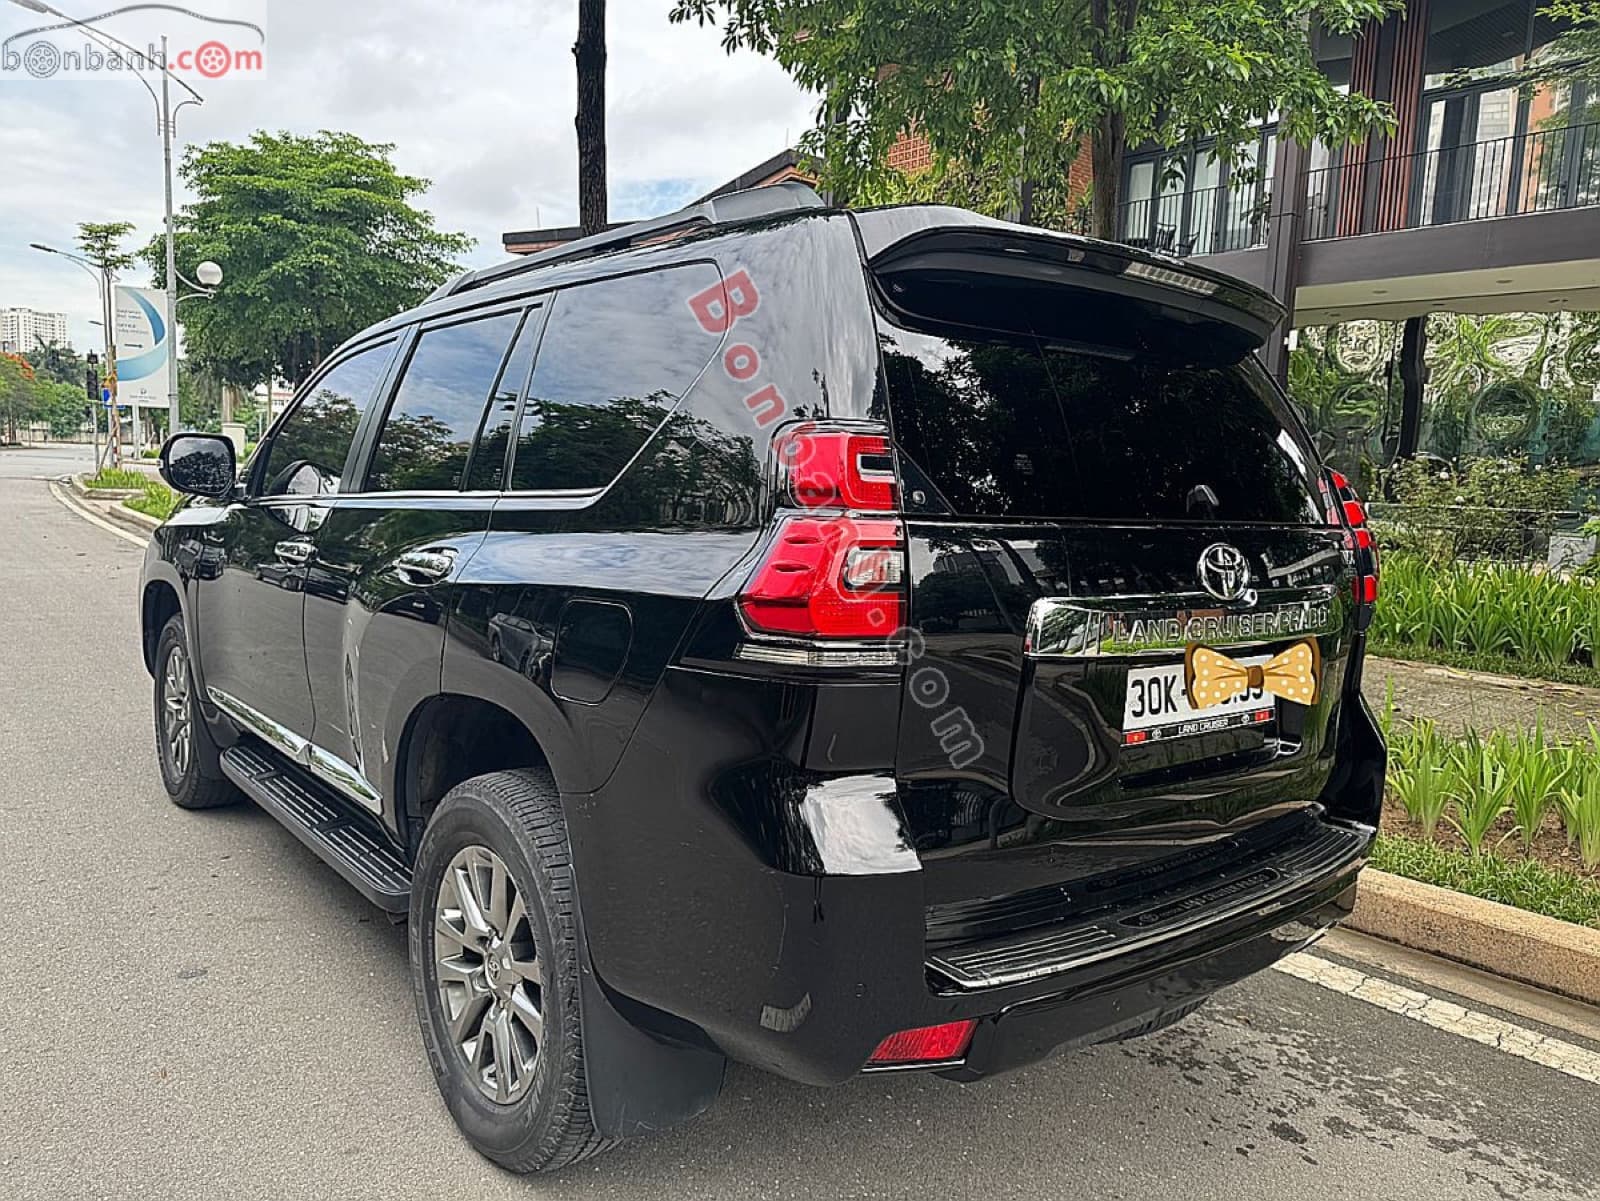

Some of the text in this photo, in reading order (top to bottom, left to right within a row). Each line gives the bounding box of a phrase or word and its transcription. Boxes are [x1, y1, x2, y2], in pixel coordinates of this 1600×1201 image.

[1113, 619, 1181, 645] LAND
[1187, 612, 1279, 641] CRUISER
[1178, 719, 1229, 734] LAND CRUISER
